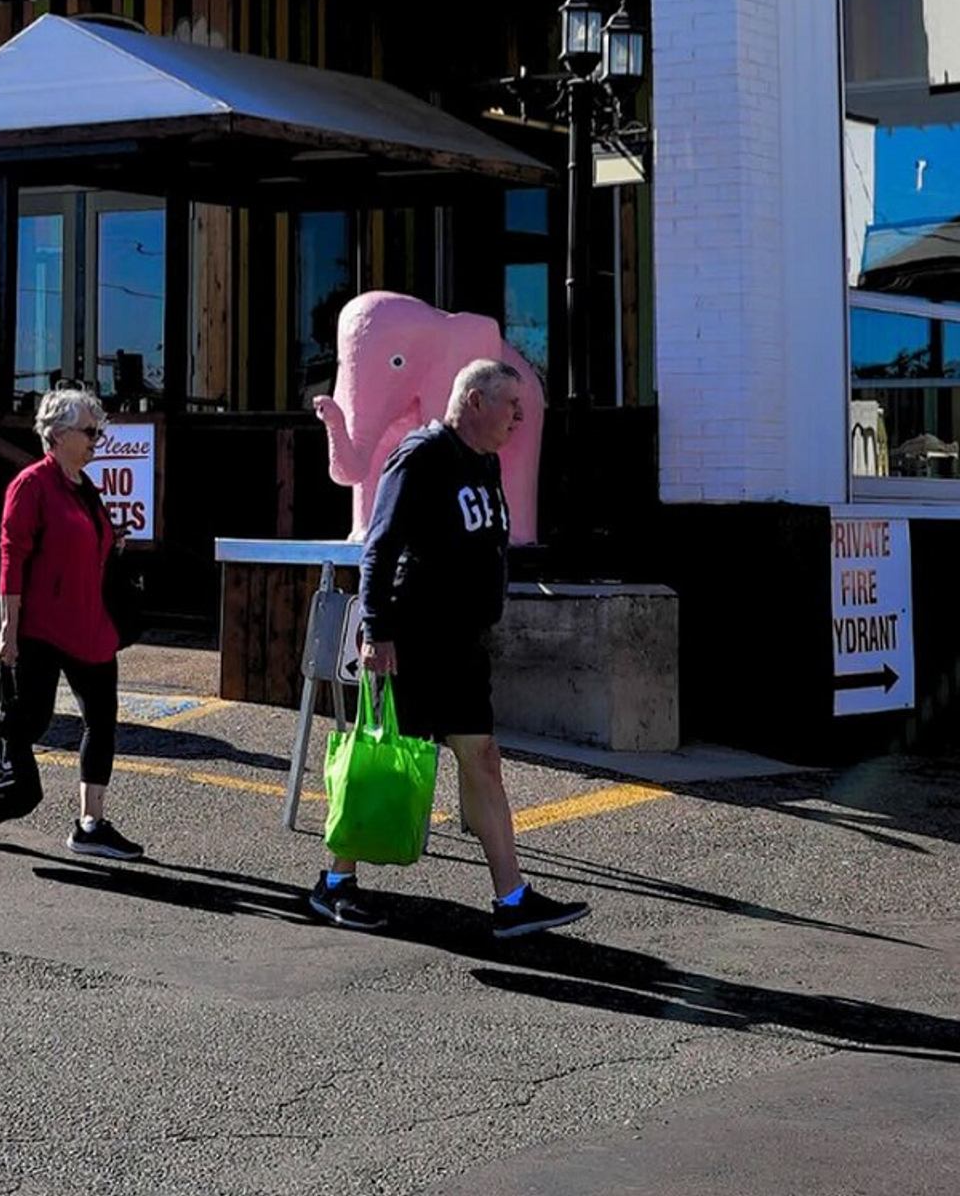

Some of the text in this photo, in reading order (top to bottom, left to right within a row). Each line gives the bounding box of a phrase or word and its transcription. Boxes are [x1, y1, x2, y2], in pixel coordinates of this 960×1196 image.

[95, 435, 150, 454] Please
[103, 468, 133, 496] NO
[105, 502, 145, 531] ETS
[832, 522, 891, 558] RIVATE
[842, 570, 877, 606] FIRE
[833, 614, 898, 655] YDRANT
